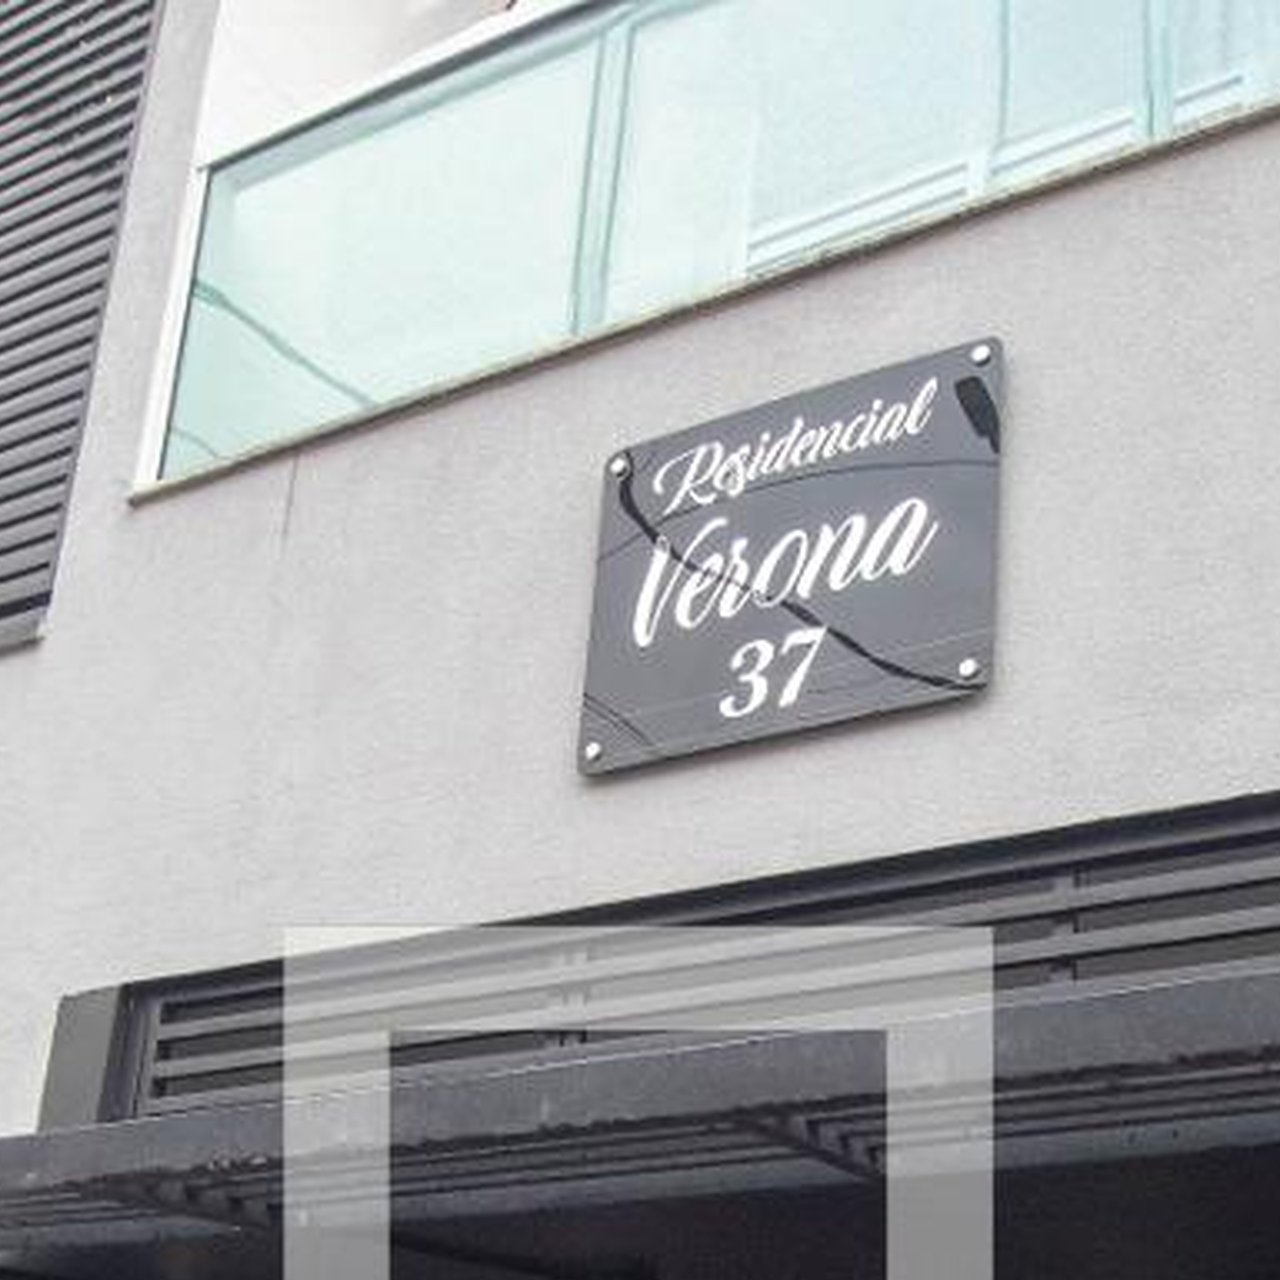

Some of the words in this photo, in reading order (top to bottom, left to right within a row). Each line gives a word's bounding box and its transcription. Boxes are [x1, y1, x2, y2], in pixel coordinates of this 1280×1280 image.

[653, 376, 938, 516] Residencial
[632, 497, 940, 648] Verona
[719, 626, 829, 719] 37
